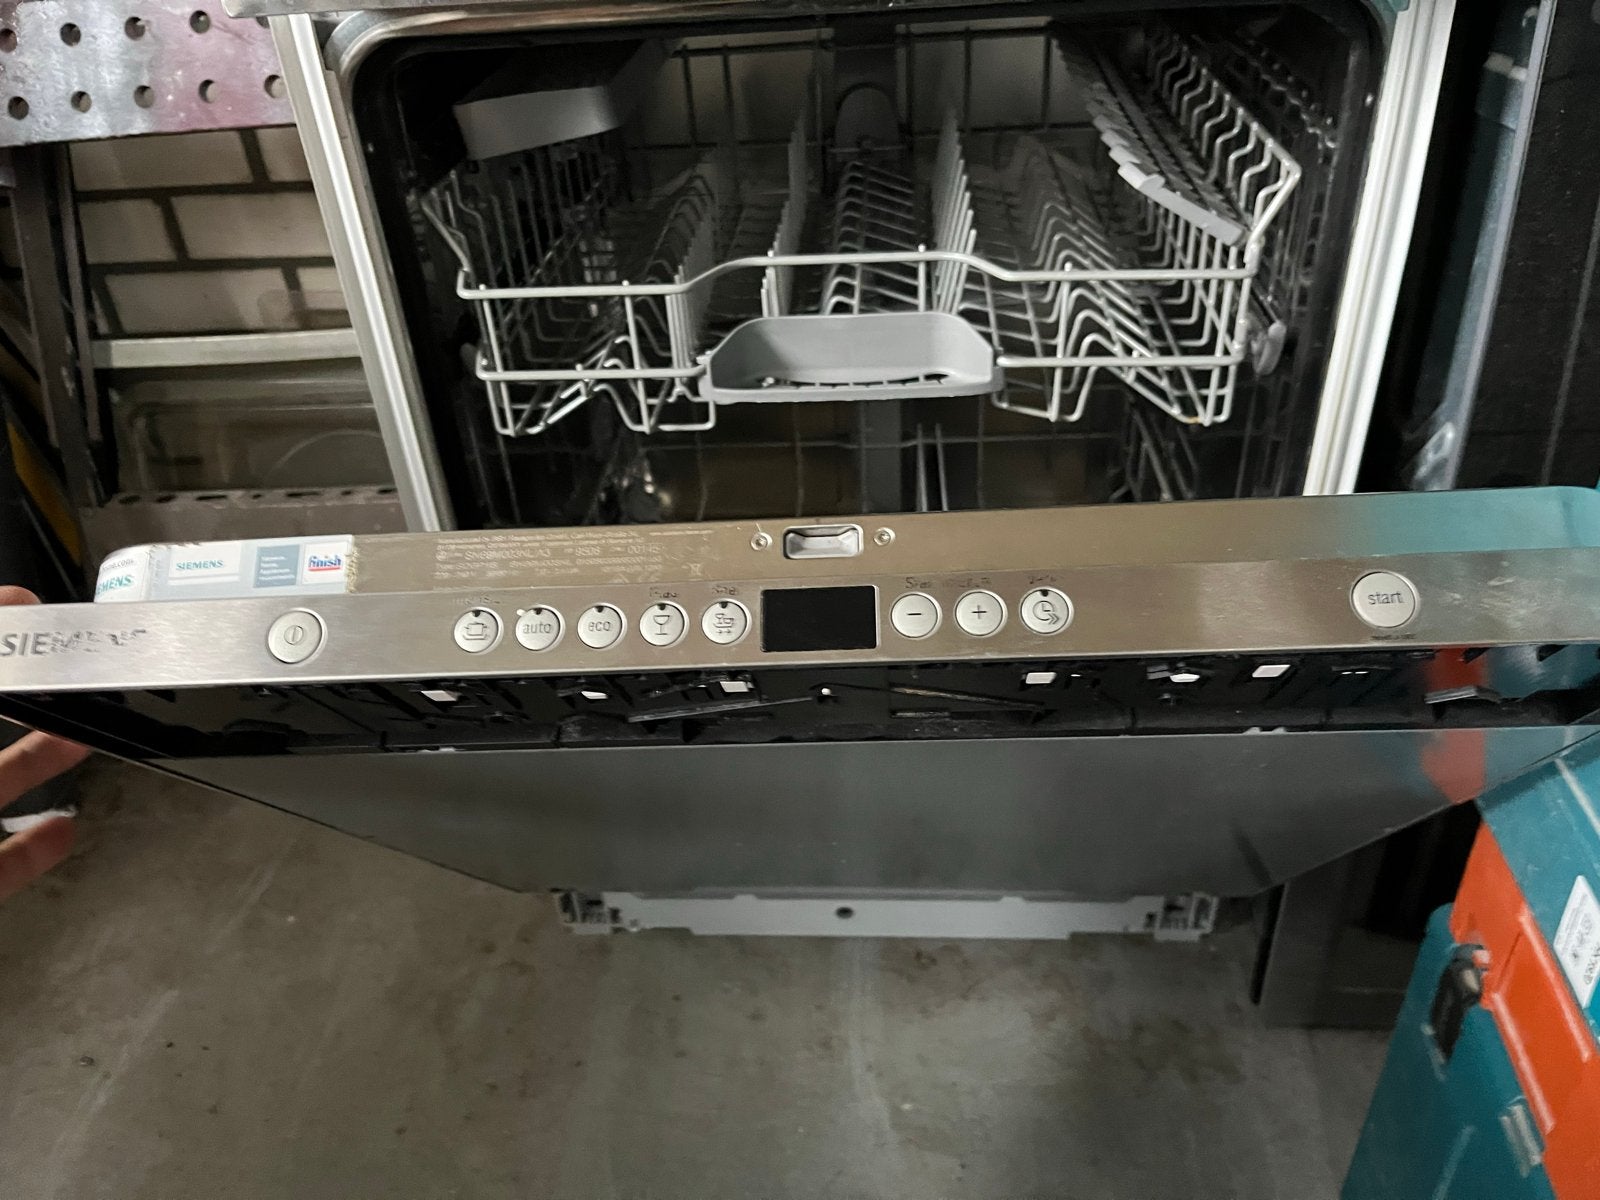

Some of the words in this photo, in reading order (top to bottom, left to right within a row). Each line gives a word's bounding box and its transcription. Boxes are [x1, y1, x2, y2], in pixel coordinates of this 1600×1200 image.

[176, 559, 224, 571] SIEMENS
[308, 554, 342, 569] finish
[1367, 591, 1406, 606] start
[522, 621, 553, 634] auto
[587, 620, 612, 632] eco
